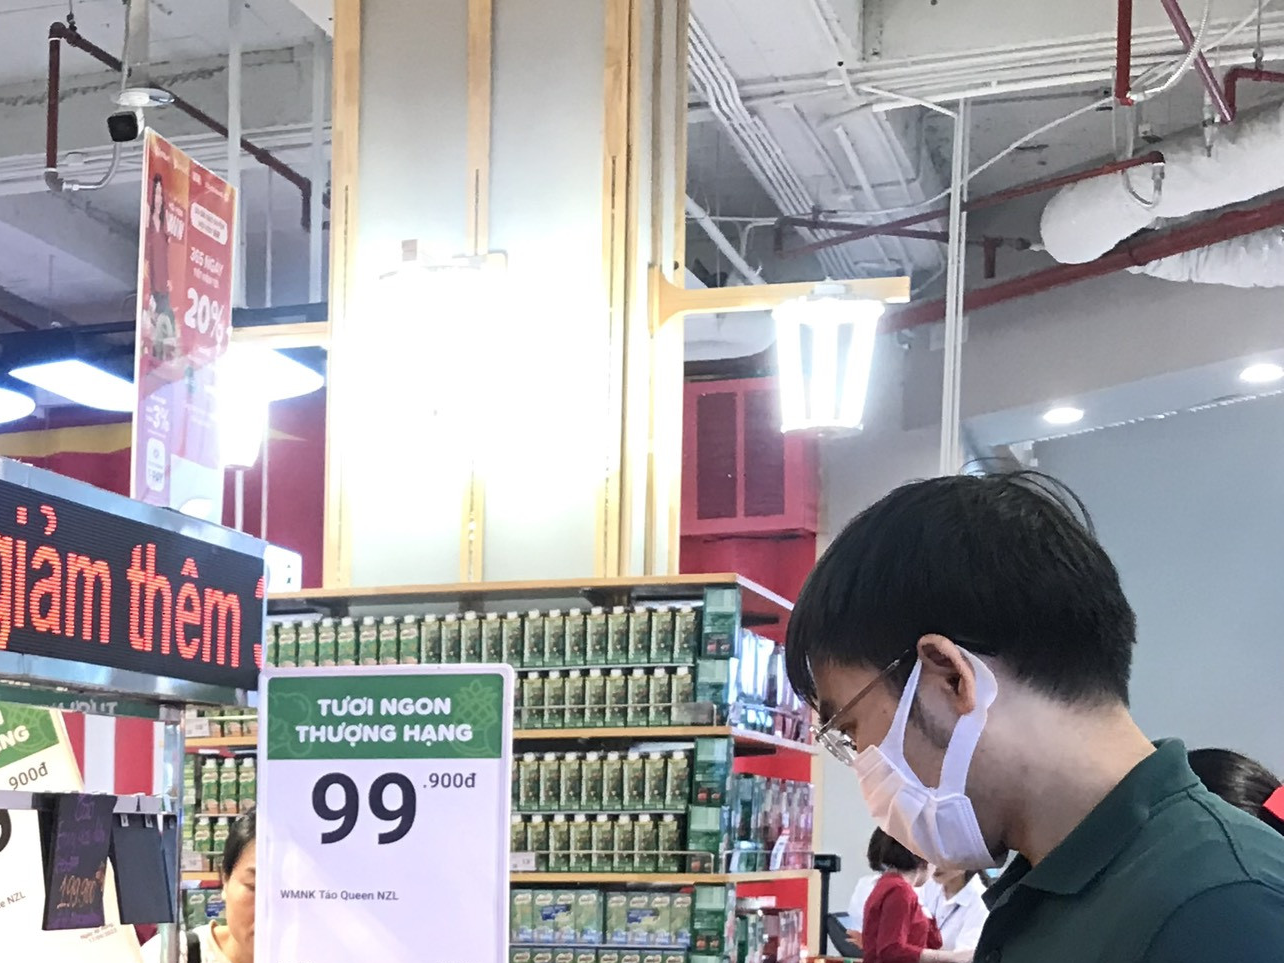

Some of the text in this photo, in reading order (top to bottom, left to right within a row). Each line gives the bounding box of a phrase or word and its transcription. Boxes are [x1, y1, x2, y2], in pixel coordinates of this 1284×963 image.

[184, 287, 225, 342] 20%
[126, 543, 241, 668] thêm
[317, 695, 451, 717] TƯƠI NGON
[295, 721, 473, 748] THƯỢNG HẠNG
[311, 772, 476, 845] 99 .900đ
[6, 891, 27, 906] NZL
[280, 889, 399, 901] WMNK Táo Queen NZL
